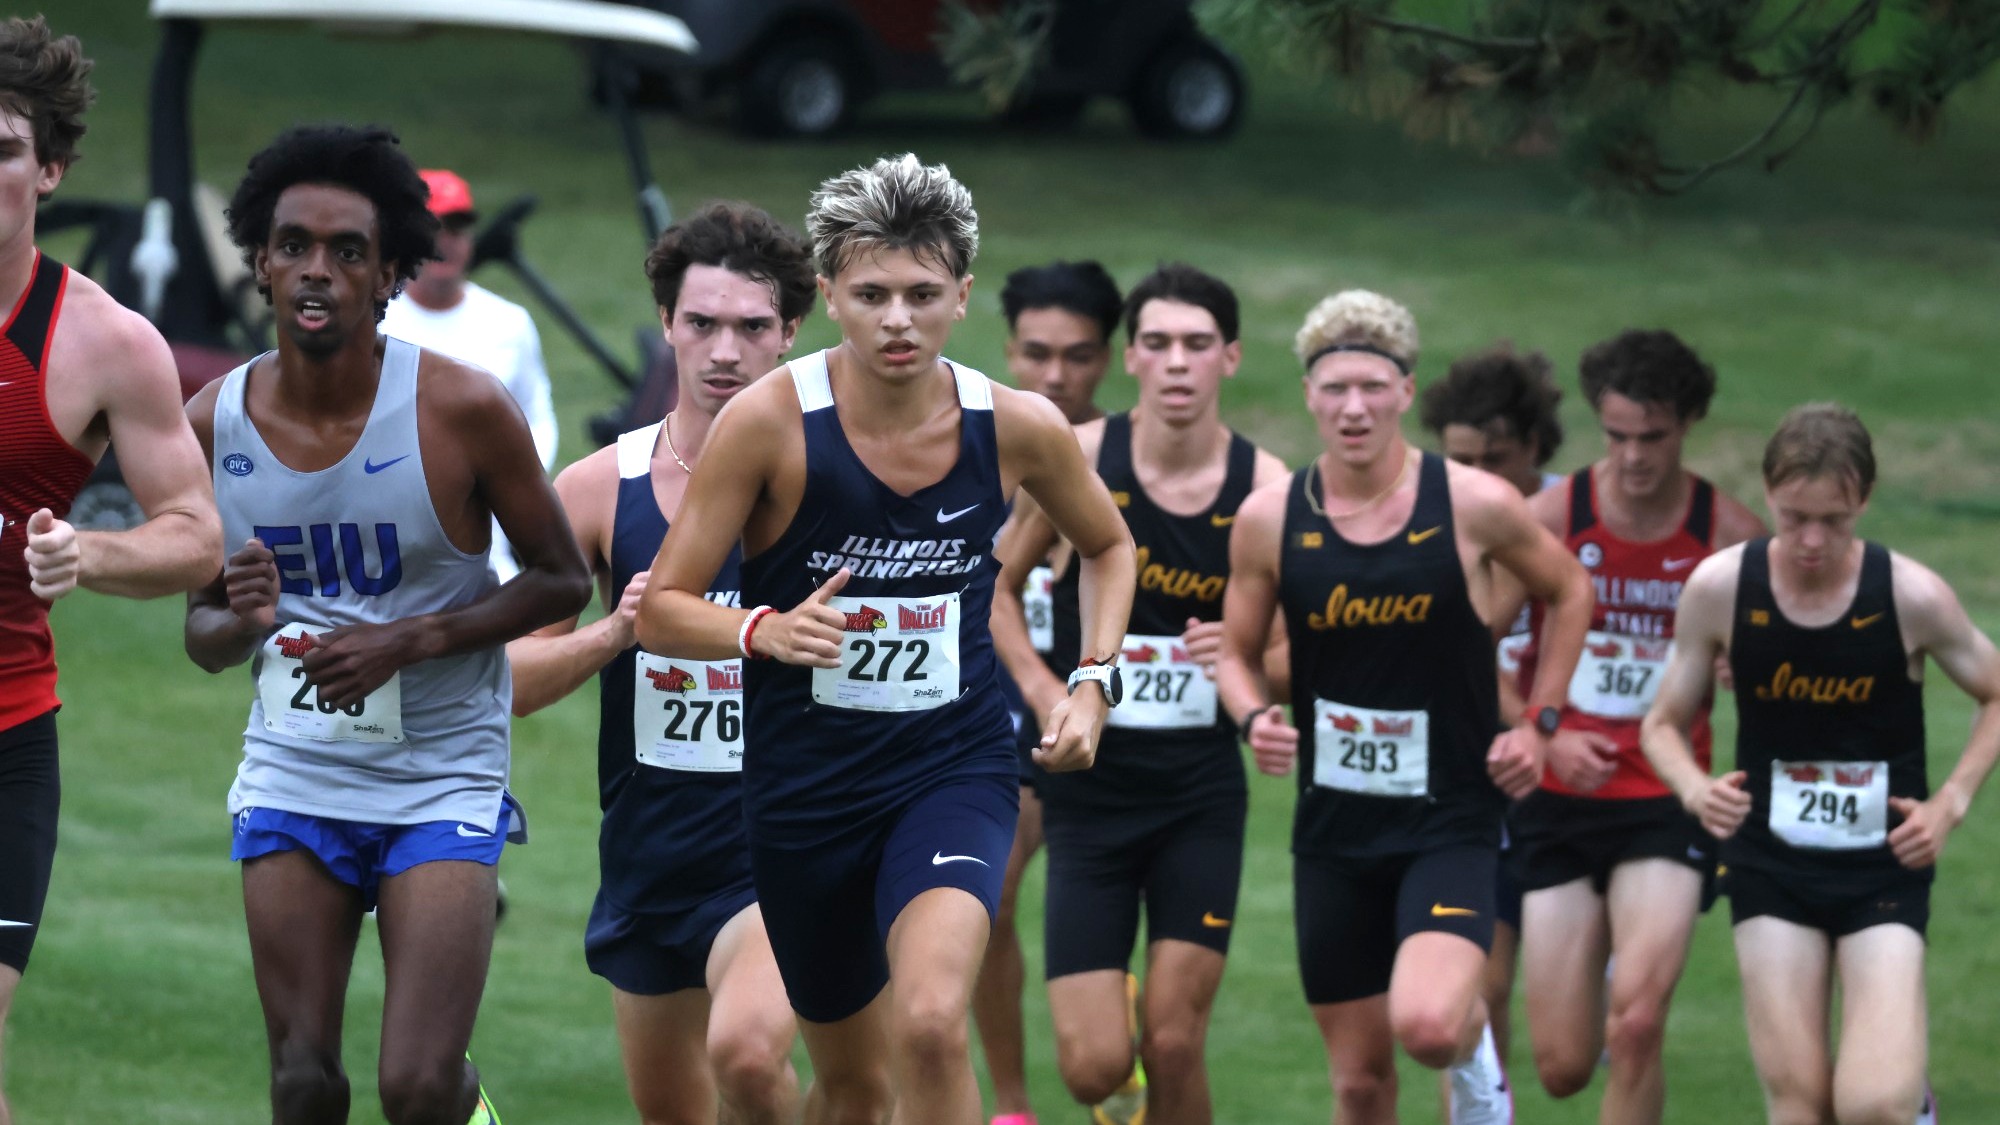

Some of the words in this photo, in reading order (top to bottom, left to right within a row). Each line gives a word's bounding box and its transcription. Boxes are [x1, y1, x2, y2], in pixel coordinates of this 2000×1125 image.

[229, 459, 248, 470] OVC
[253, 523, 402, 597] EIU
[839, 535, 967, 559] ILLINOIS
[807, 551, 982, 579] SPRINGFIELD
[1136, 546, 1227, 600] Iowa
[898, 600, 947, 630] VALLEY
[1307, 583, 1433, 630] Iowa
[706, 664, 743, 690] VALL
[848, 639, 929, 682] 272
[1133, 668, 1193, 703] 287
[1596, 663, 1653, 696] 367
[1756, 661, 1875, 704] Iowa
[664, 699, 740, 742] 276
[1339, 737, 1397, 773] 293
[1798, 789, 1858, 824] 294
